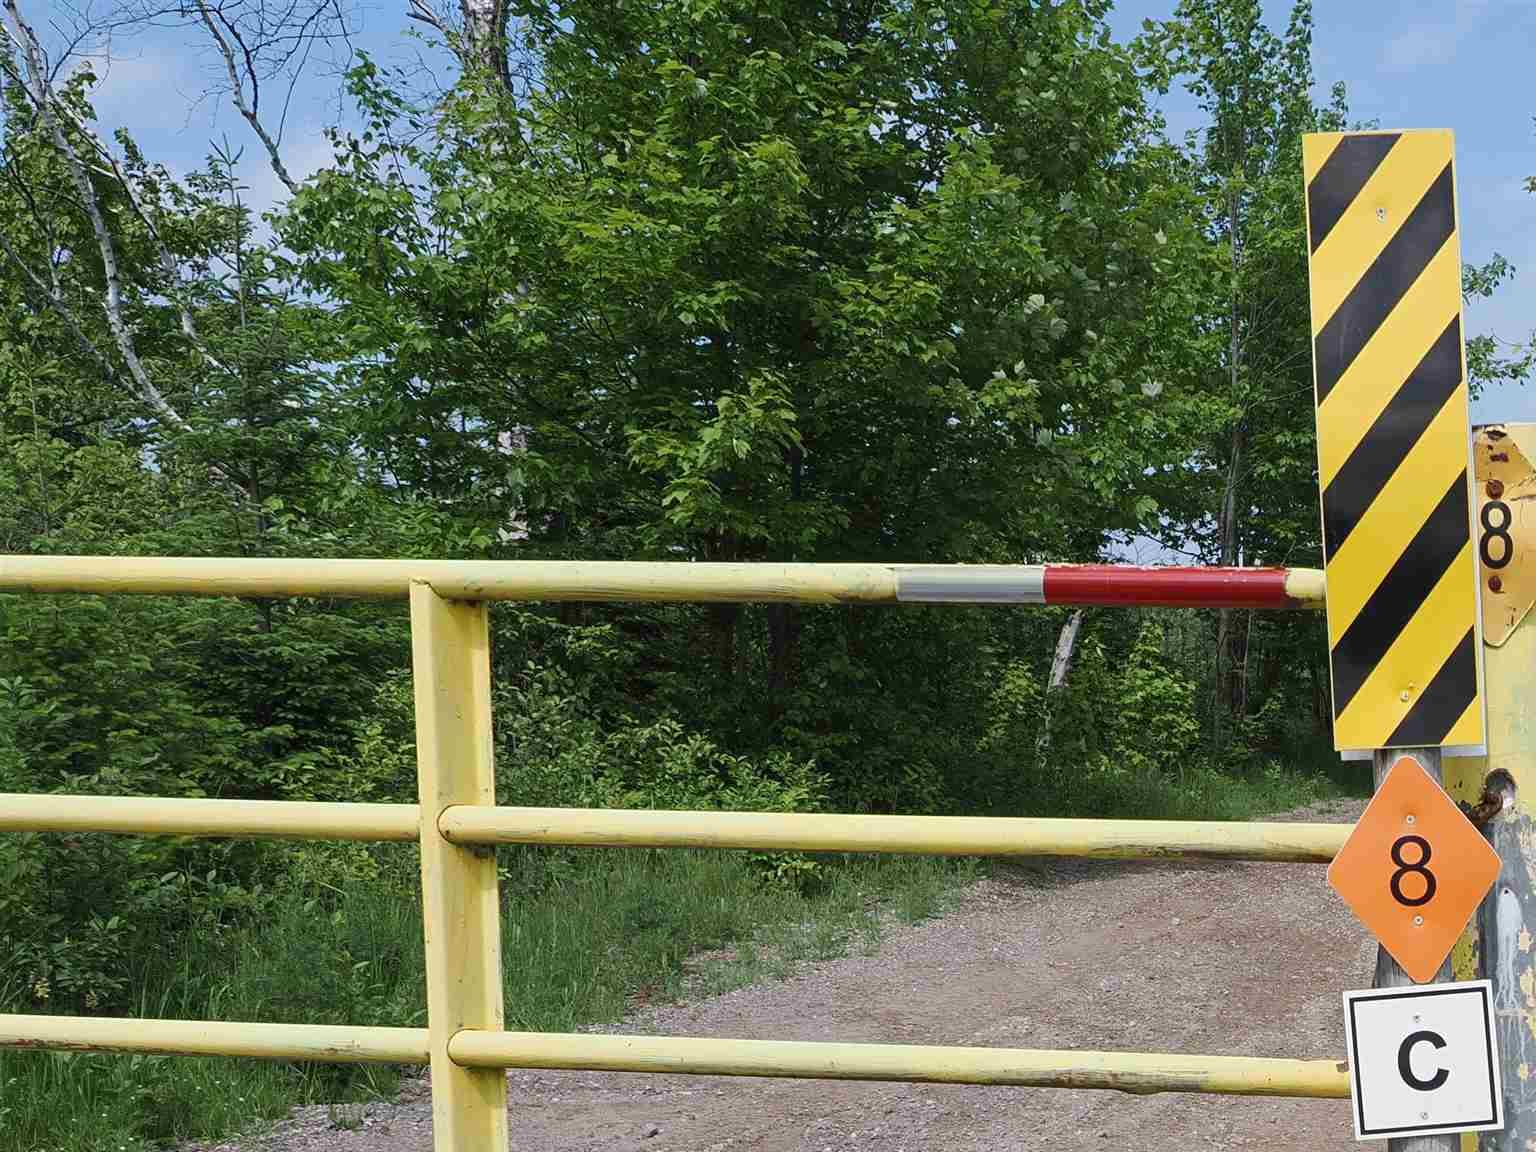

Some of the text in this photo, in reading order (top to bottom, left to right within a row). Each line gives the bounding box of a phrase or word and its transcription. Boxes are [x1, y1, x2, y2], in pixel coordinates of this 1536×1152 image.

[1480, 500, 1514, 570] 8
[1390, 835, 1437, 907] 8
[1397, 1030, 1450, 1092] C
